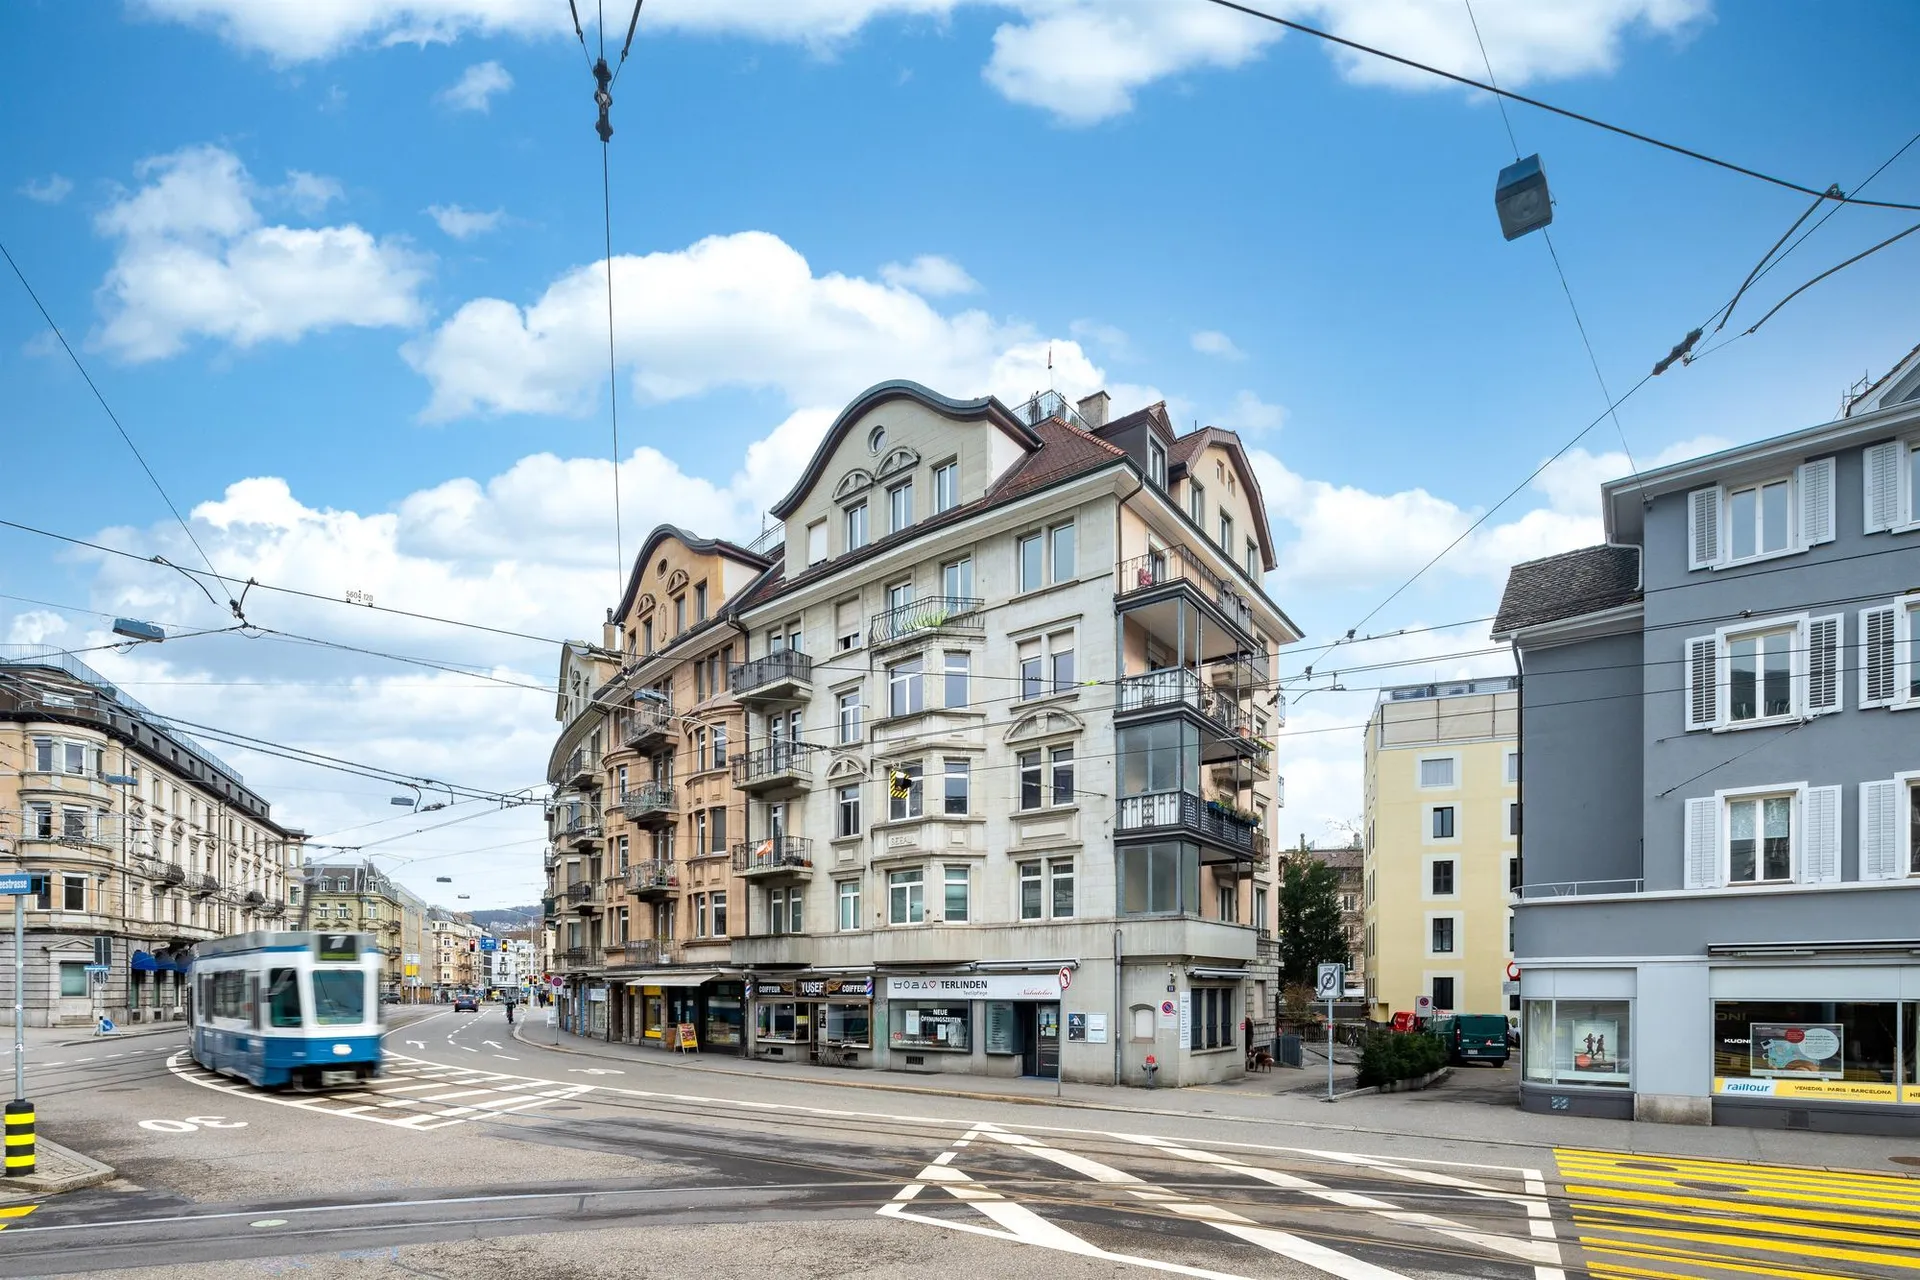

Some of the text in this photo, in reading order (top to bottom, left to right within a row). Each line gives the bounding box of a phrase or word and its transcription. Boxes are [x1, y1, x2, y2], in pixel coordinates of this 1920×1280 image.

[329, 936, 347, 949] 7
[758, 985, 781, 993] COIFFEUR
[801, 981, 824, 993] YUSEF
[842, 984, 867, 993] COIFFEUR
[940, 980, 988, 989] TERLINDEN
[933, 1008, 948, 1016] NEUE
[920, 1015, 962, 1023] ÖFFNUNGSZEITEN
[1727, 1083, 1770, 1092] railtour
[137, 1116, 249, 1132] 30
